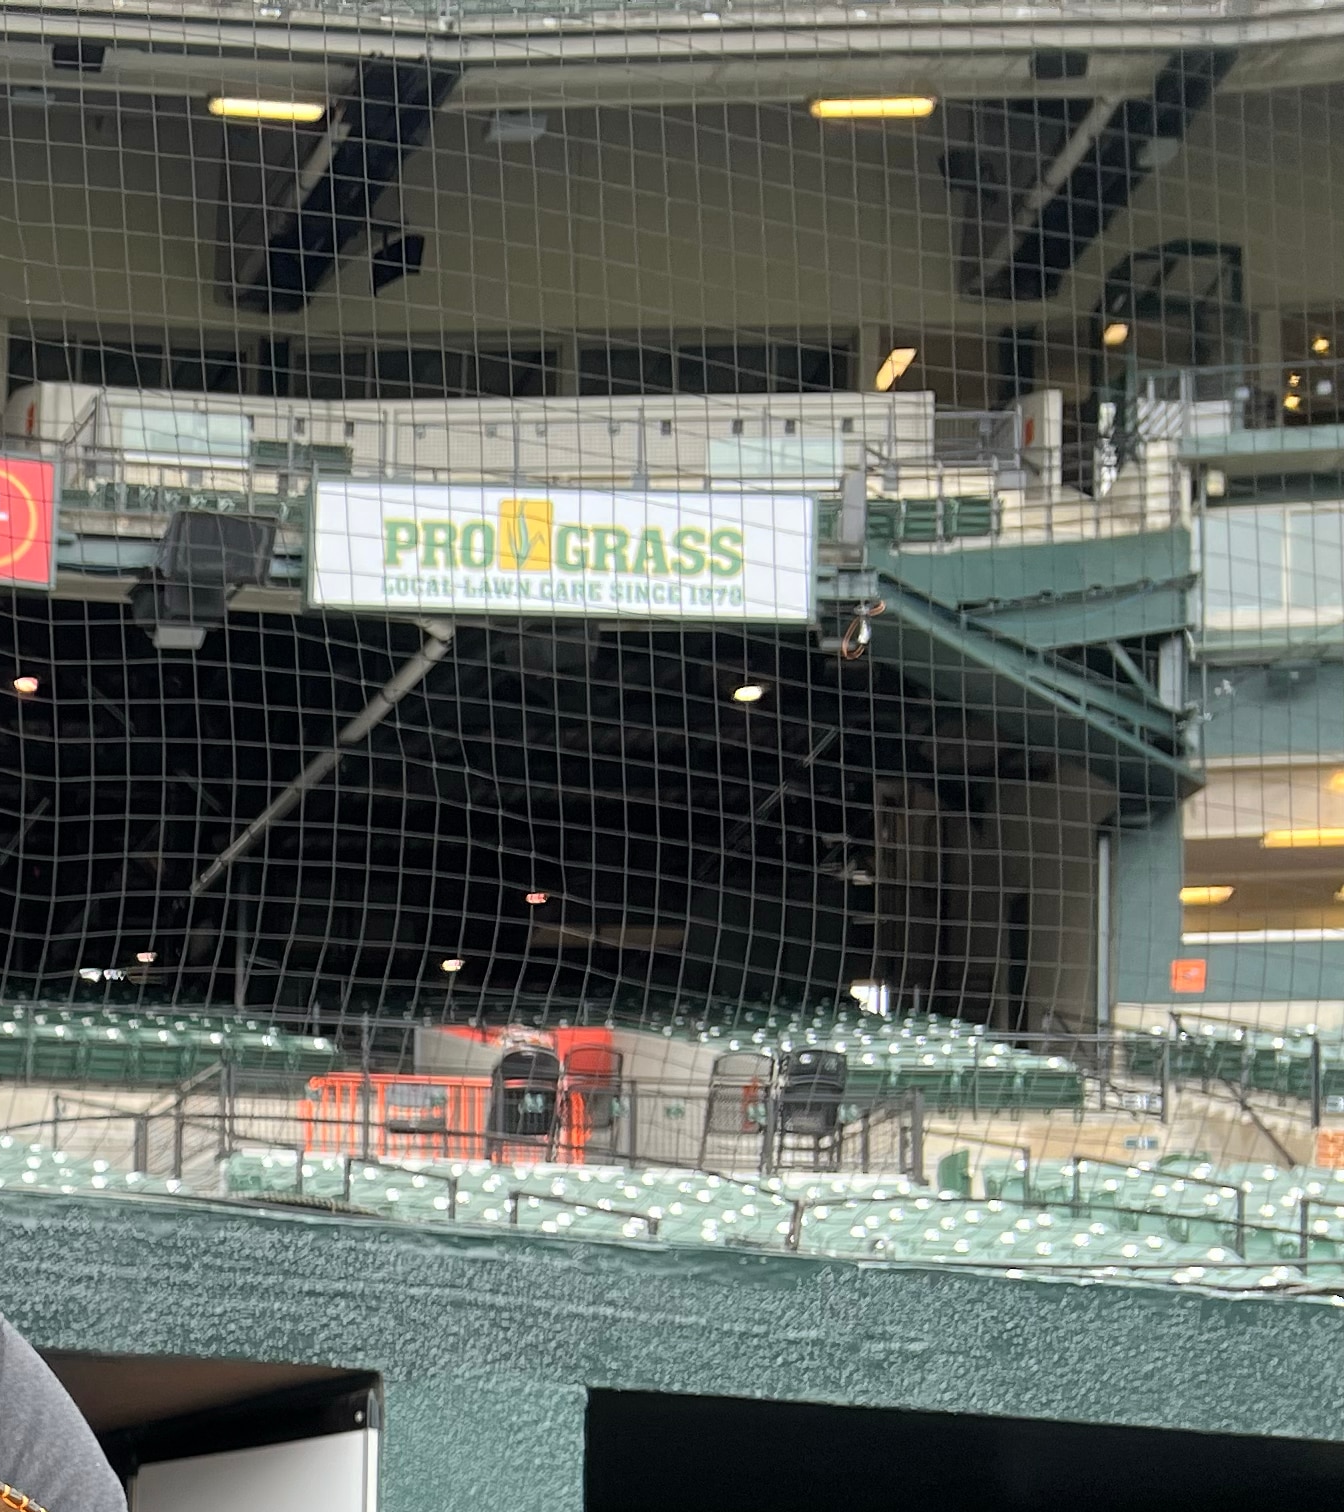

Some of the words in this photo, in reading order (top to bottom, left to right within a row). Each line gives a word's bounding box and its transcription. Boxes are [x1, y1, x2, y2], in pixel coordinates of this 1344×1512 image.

[384, 519, 497, 571] PRO
[555, 522, 745, 578] GRASS
[381, 574, 457, 598] LOCAL
[464, 575, 532, 600] LAWN
[540, 578, 602, 602] CARE
[609, 582, 681, 605] SINCE
